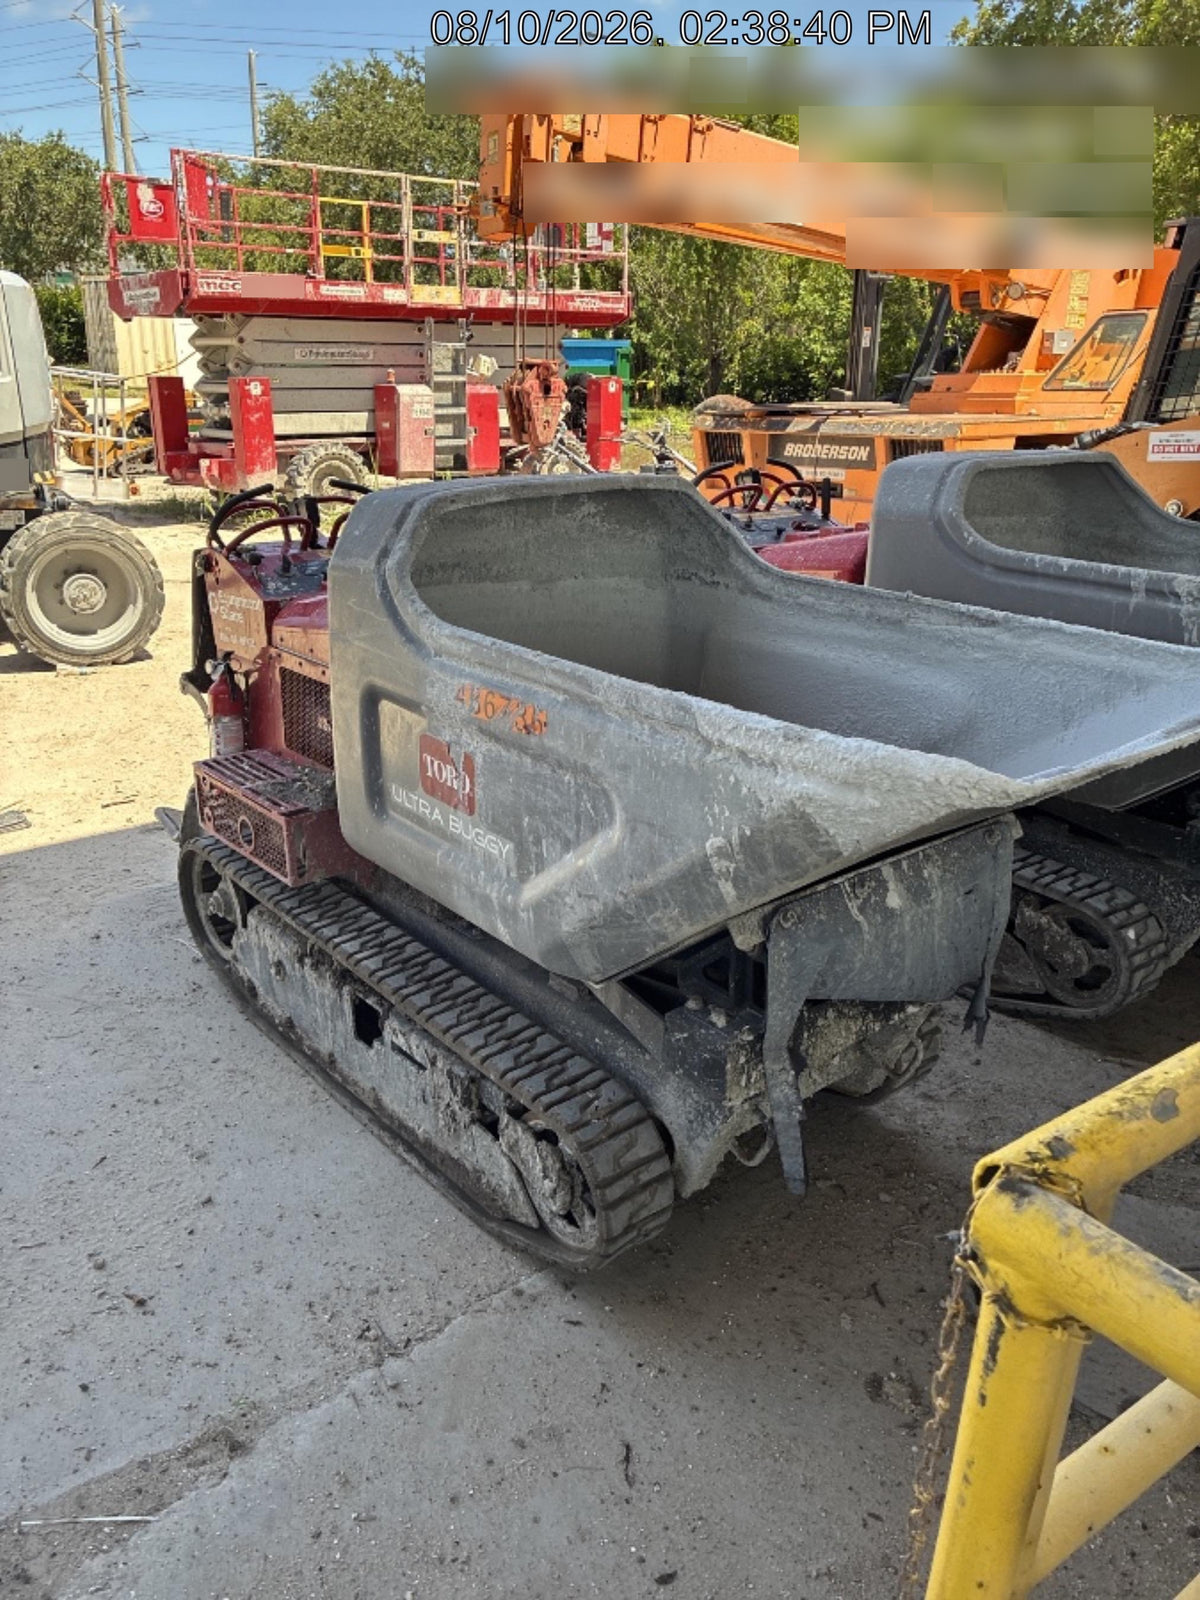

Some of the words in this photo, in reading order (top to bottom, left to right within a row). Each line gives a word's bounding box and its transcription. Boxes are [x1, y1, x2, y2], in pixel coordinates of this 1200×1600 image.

[784, 442, 870, 461] BRODERSON
[391, 784, 444, 825] ULTRA
[449, 813, 510, 860] BUGGY
